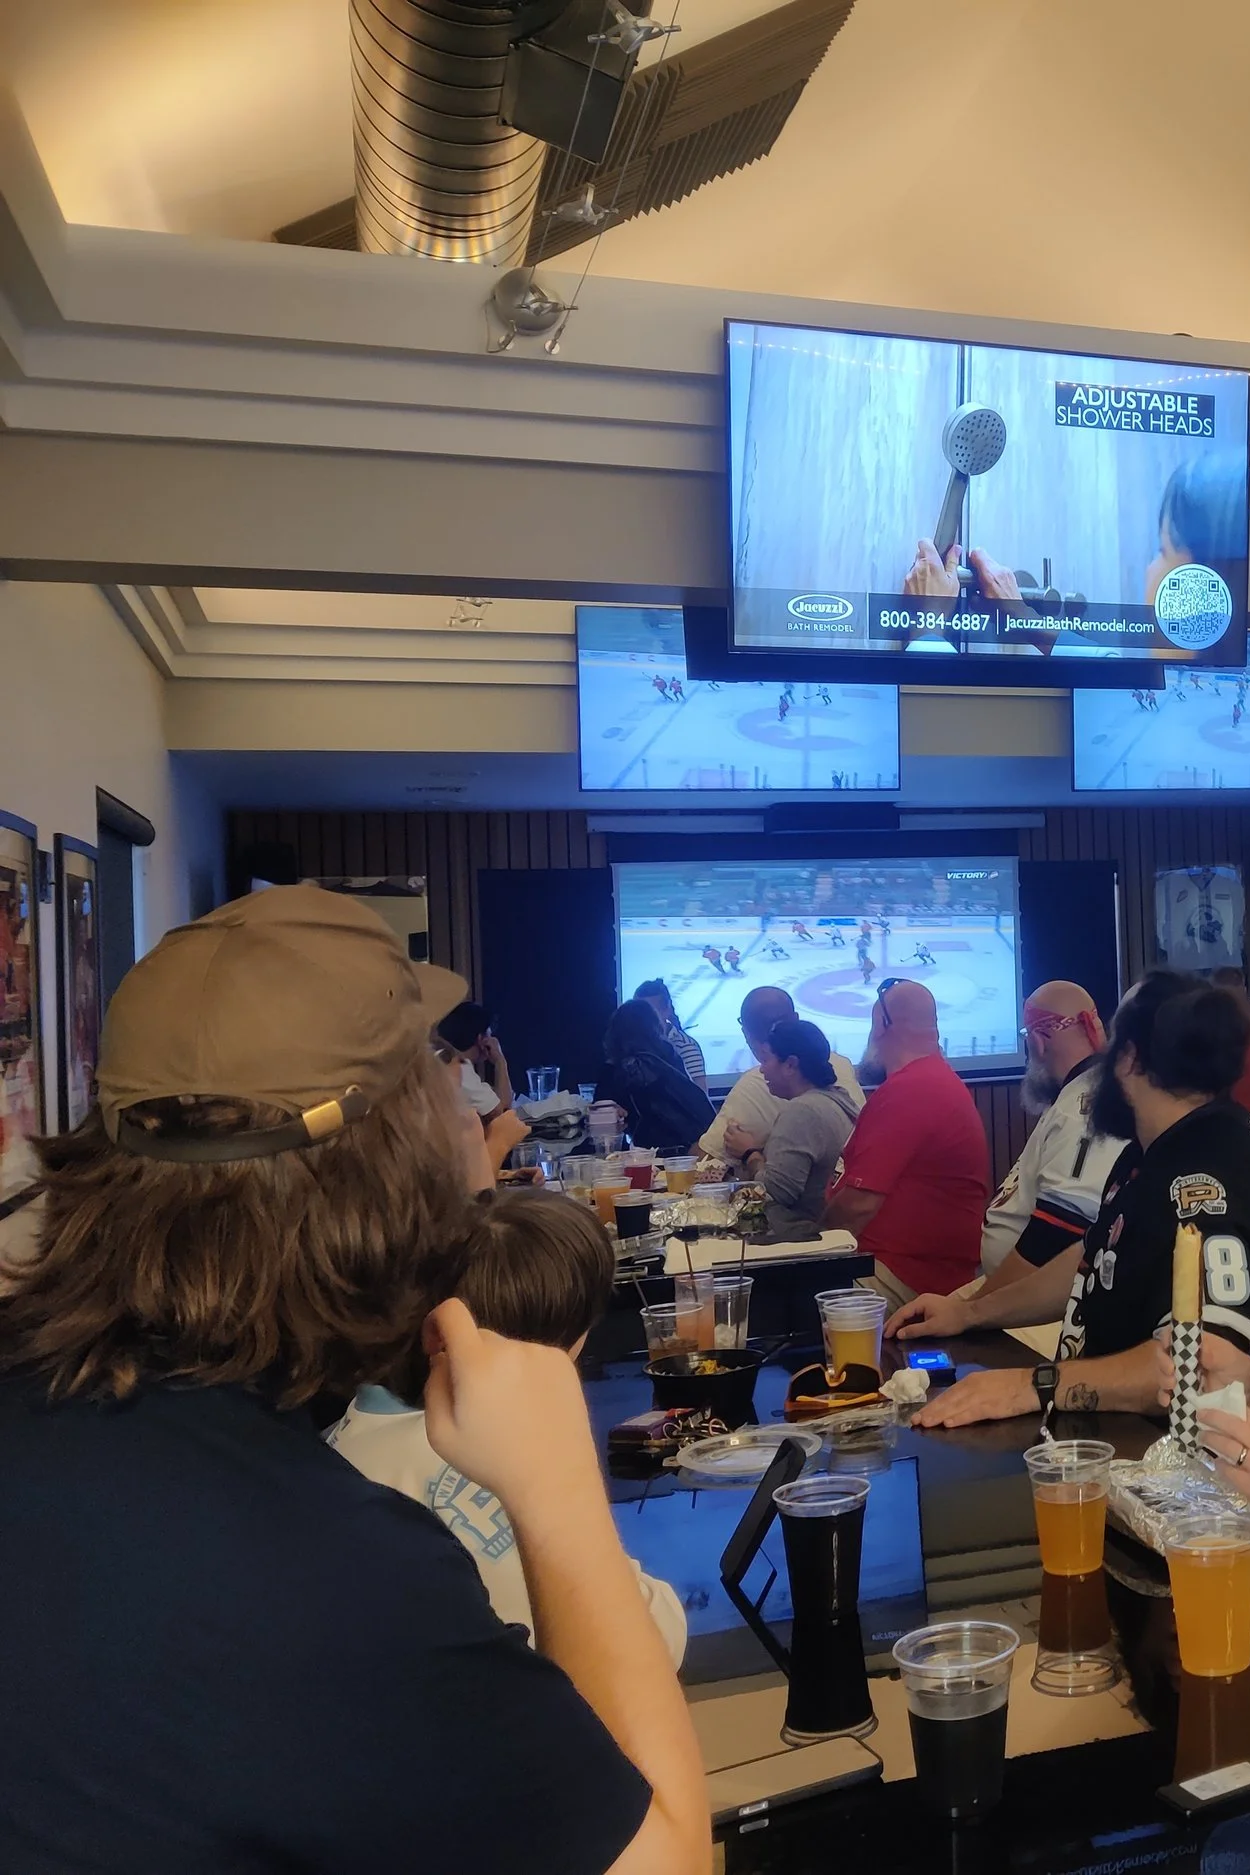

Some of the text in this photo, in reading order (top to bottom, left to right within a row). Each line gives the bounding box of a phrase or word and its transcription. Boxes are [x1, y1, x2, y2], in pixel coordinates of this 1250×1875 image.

[1072, 386, 1198, 415] ADJUSTABLE
[1056, 405, 1213, 436] SHOWER HEADS
[796, 601, 846, 614] Jacuzzi
[787, 622, 854, 633] BATH REMODEL
[879, 610, 991, 632] 800-384-6887
[1004, 614, 1155, 634] JacuzziBathRemodel.com
[1203, 1234, 1250, 1306] 8
